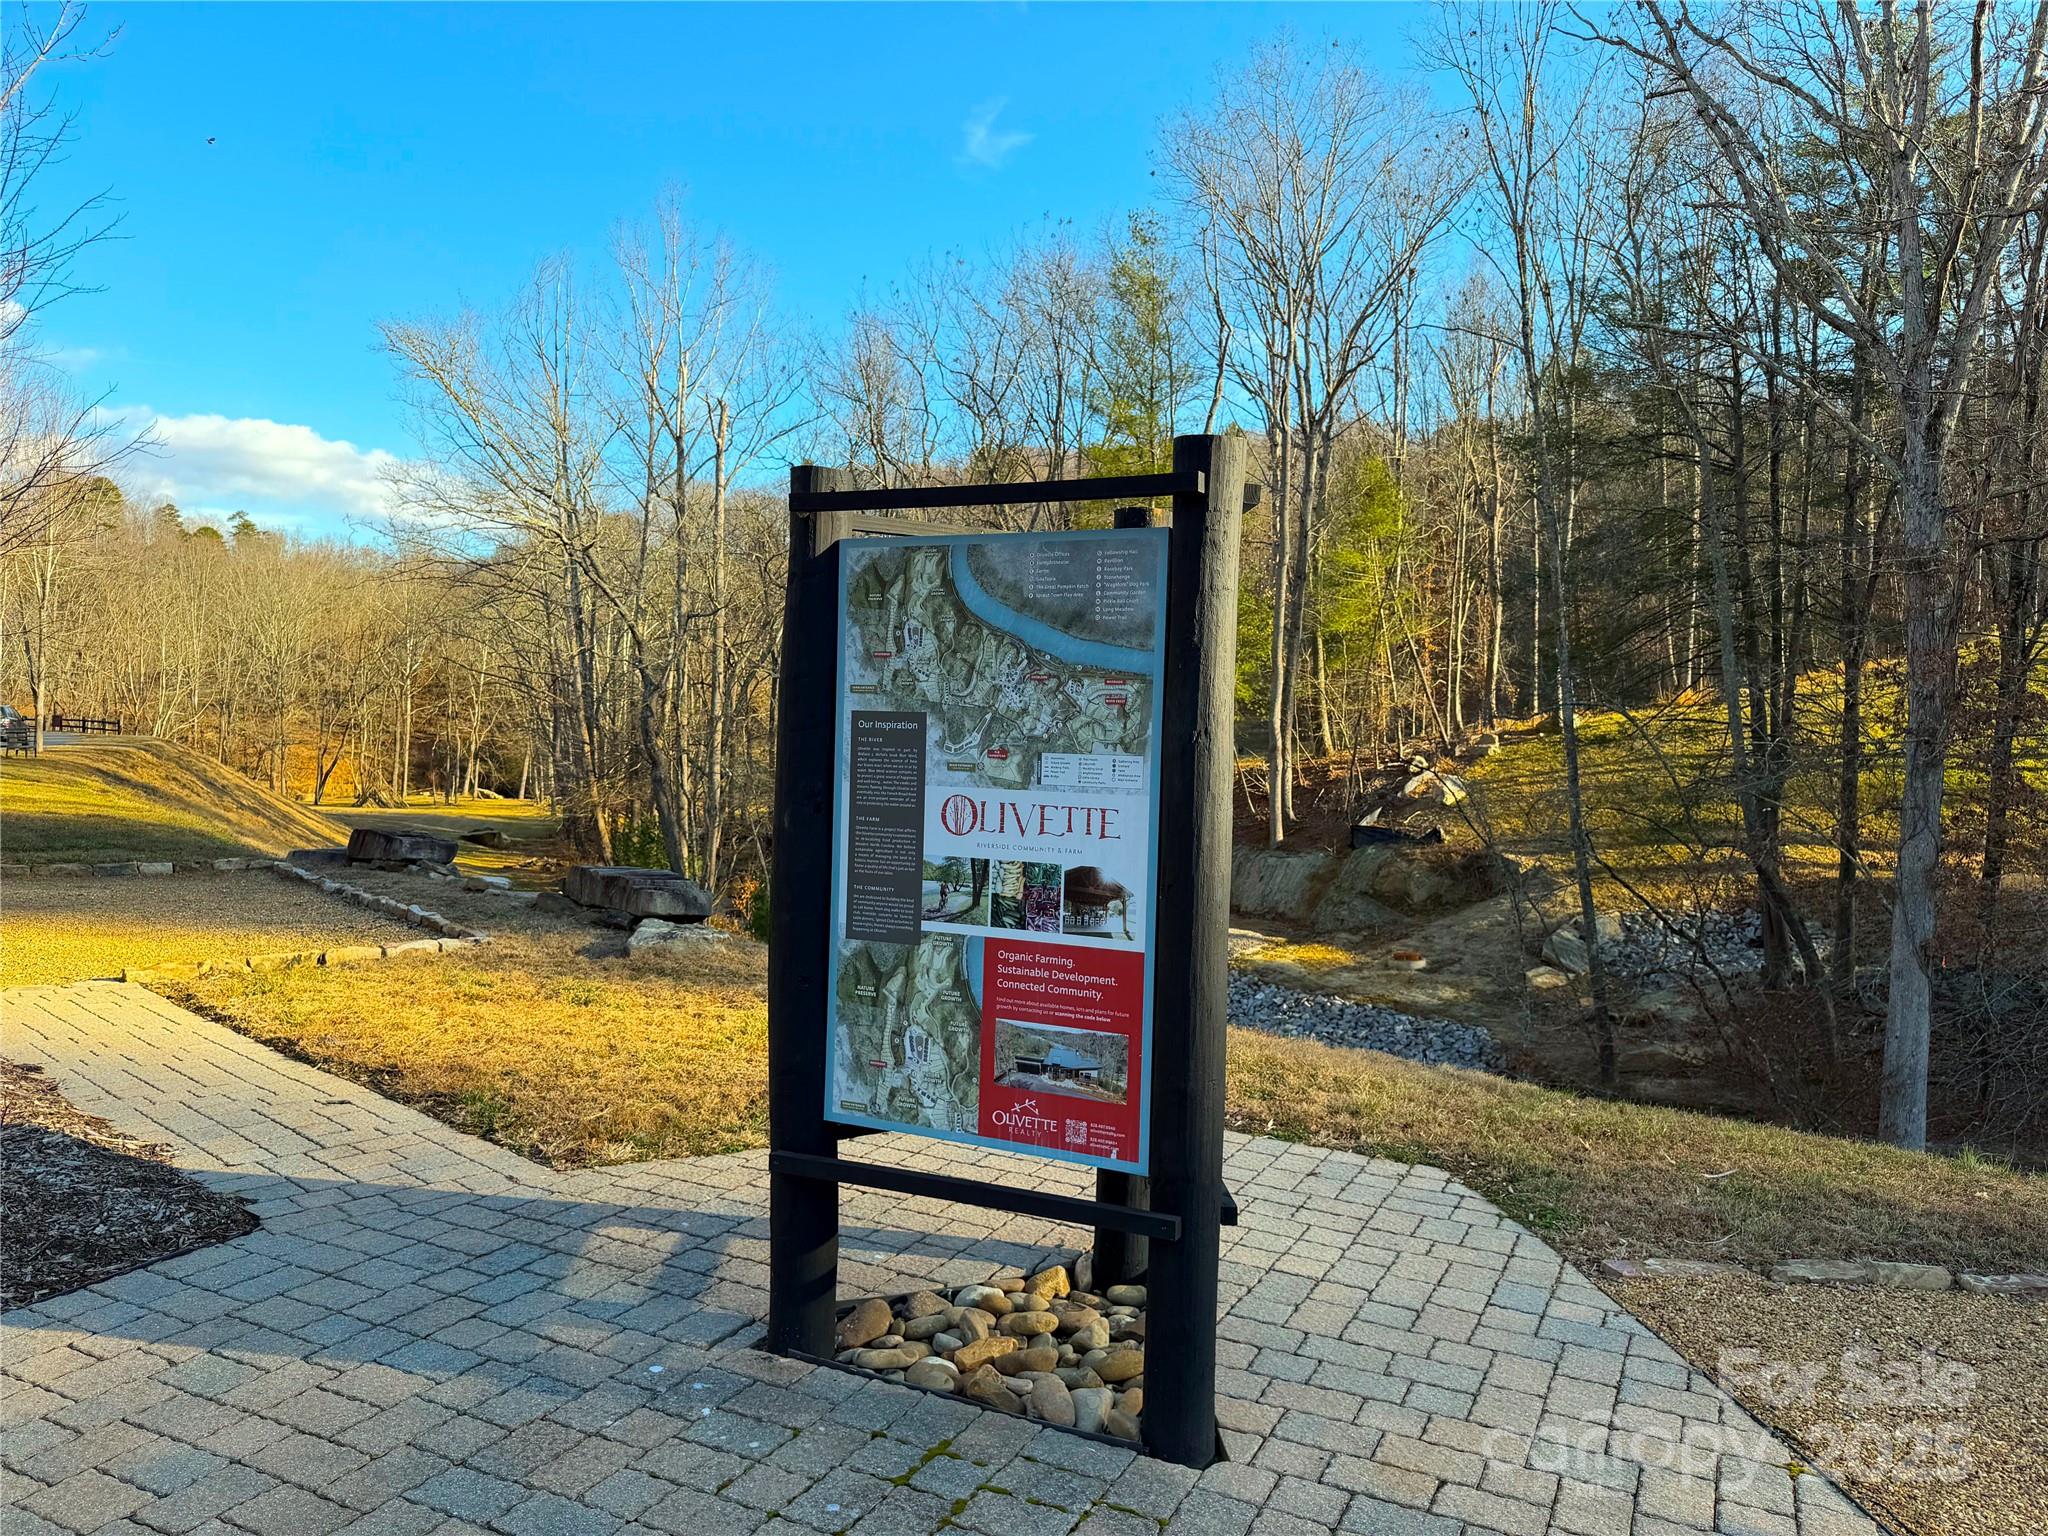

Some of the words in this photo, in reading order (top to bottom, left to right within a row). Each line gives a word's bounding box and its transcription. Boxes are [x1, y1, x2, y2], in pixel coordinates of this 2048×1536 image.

[858, 720, 873, 728] Our
[875, 720, 918, 731] Inspiration
[940, 794, 1121, 840] OLIVETTE
[1012, 845, 1055, 853] COMMUNITY
[998, 950, 1033, 962] Organic
[1035, 954, 1076, 968] Farming.
[997, 964, 1049, 978] Sustainable
[1052, 970, 1118, 986] Development.
[997, 978, 1045, 993] Connected
[1048, 984, 1104, 1001] Community.
[1019, 1006, 1042, 1015] contacting
[992, 1110, 1057, 1132] OLIVETTE
[1008, 1126, 1042, 1138] REALTY
